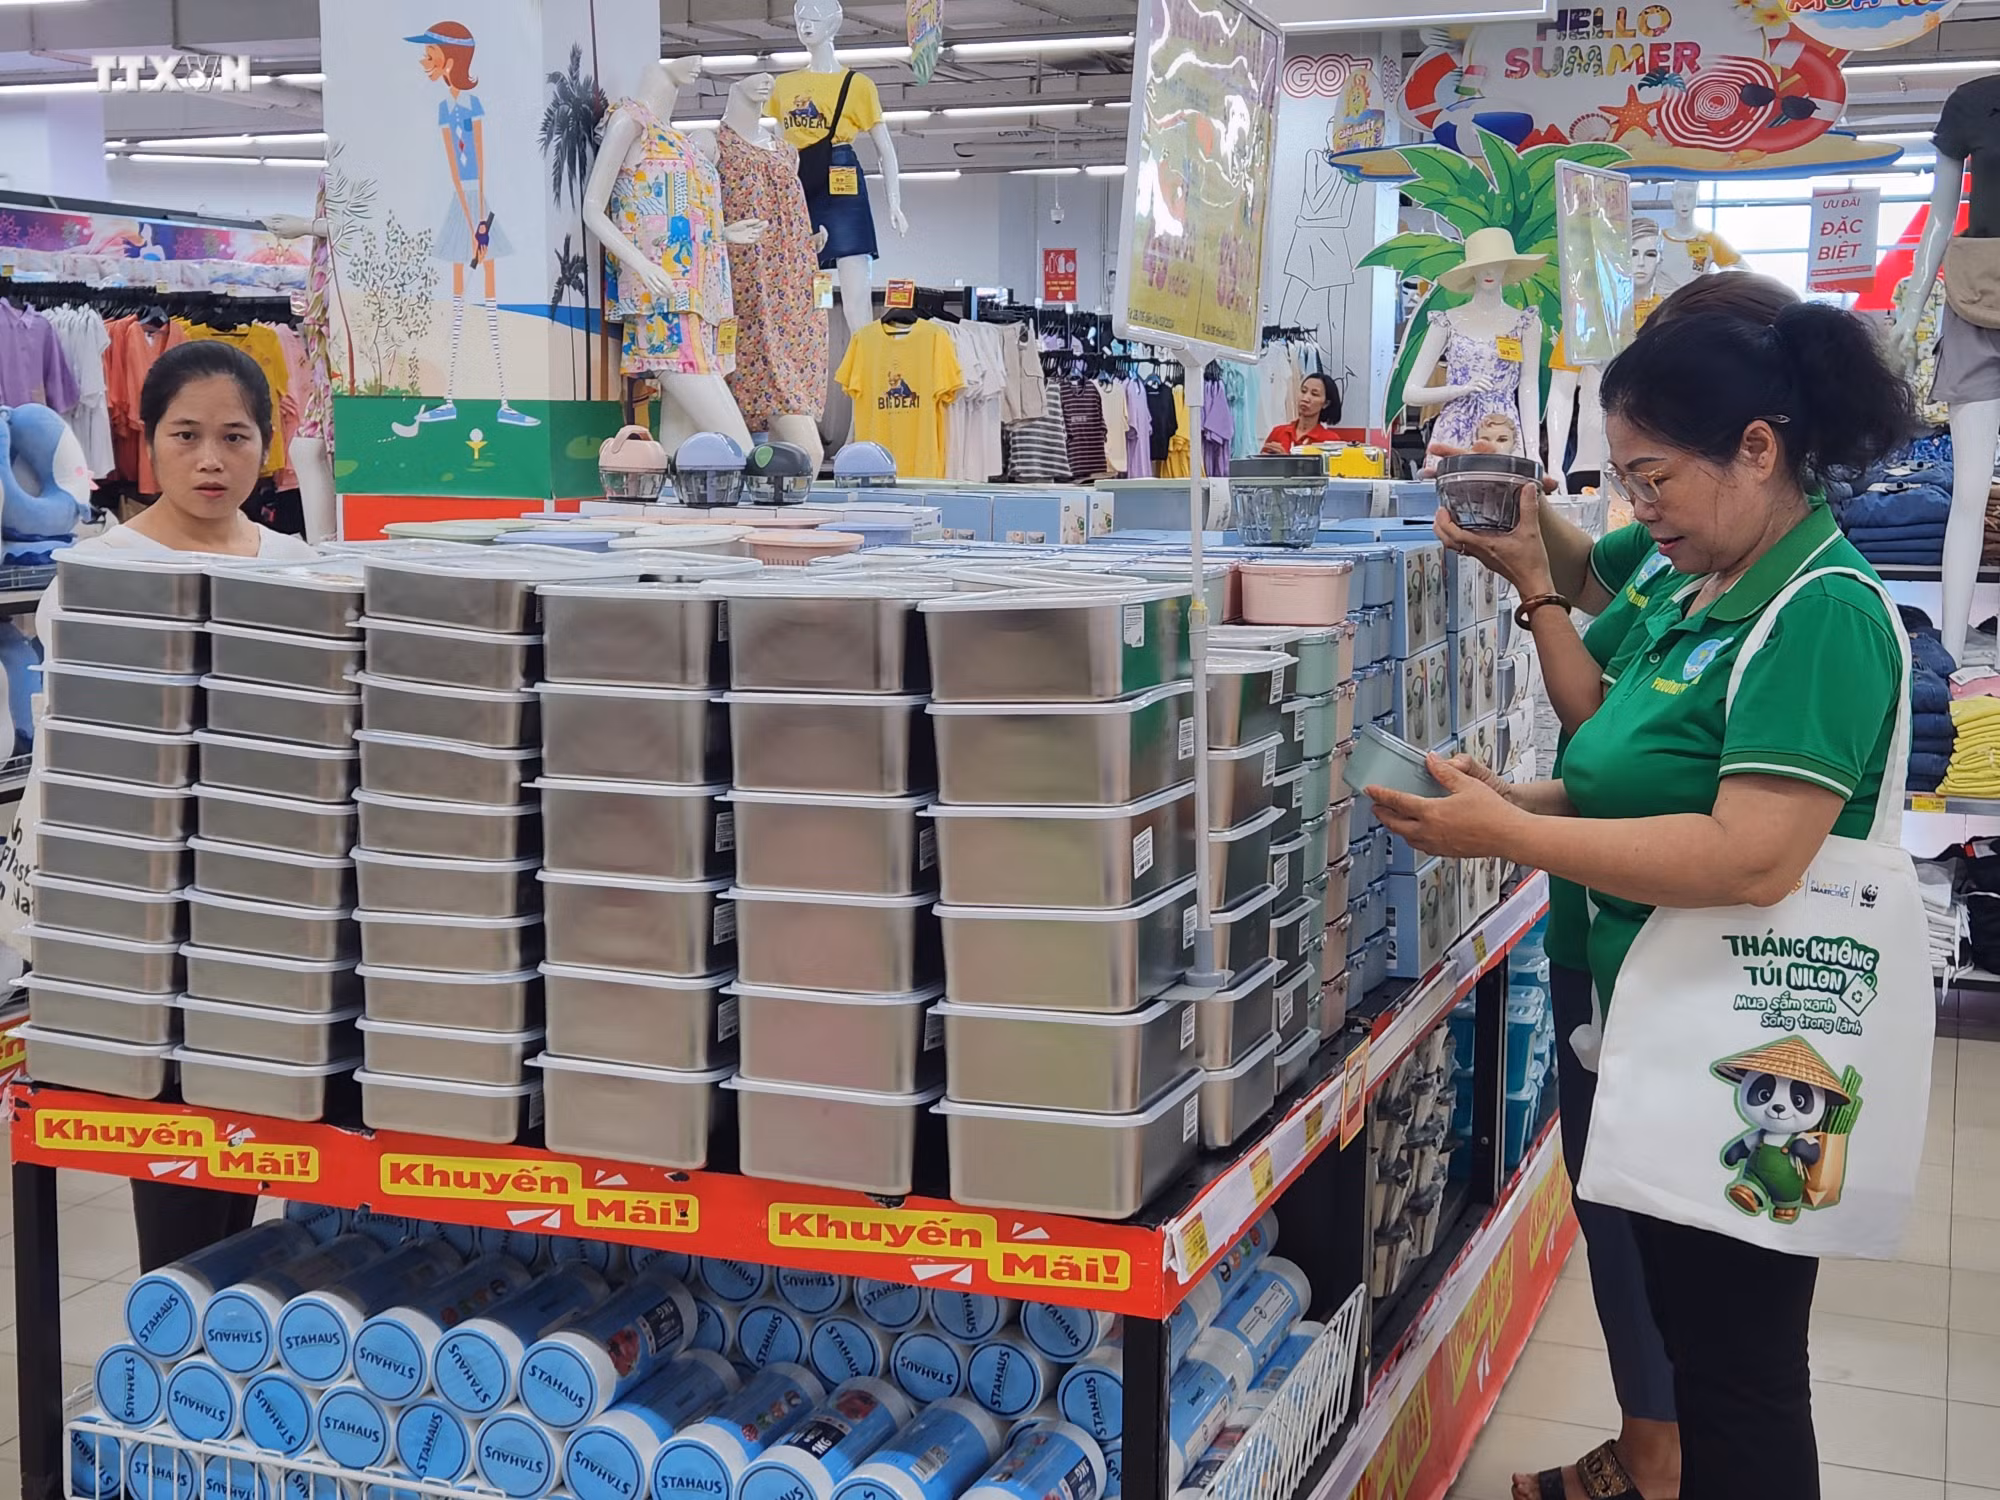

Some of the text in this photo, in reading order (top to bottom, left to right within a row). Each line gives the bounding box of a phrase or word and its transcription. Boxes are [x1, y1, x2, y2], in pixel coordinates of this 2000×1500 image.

[1536, 5, 1672, 41] HELLO
[1505, 41, 1701, 79] SUMMER
[1823, 196, 1860, 209] ƯU ĐÃI
[1820, 215, 1863, 239] ĐẶC
[1818, 240, 1862, 262] BIỆT
[1722, 928, 1876, 972] THÁNG KHÔNG
[1743, 960, 1843, 992] TÚI NILON
[1734, 990, 1836, 1013] Mua sắm xanh
[1761, 1010, 1862, 1036] Sống trong lành
[43, 1118, 203, 1147] Khuyến
[219, 1151, 310, 1176] Mãi!
[390, 1162, 568, 1195] Khuyến
[587, 1198, 689, 1227] Mãi!
[779, 1212, 982, 1248] Khuyến
[1002, 1252, 1120, 1284] Mãi!
[139, 1293, 179, 1343] STAHAUS
[208, 1328, 262, 1343] STAHAUS
[285, 1332, 340, 1349] STAHAUS
[756, 1313, 783, 1367] STAHAUS
[360, 1347, 416, 1380] STAHAUS
[448, 1343, 491, 1404] STAHAUS
[900, 1355, 954, 1386] STAHAUS
[990, 1350, 1010, 1408] STAHAUS
[125, 1356, 135, 1418] STAHAUS
[528, 1365, 585, 1409] STAHAUS
[173, 1390, 226, 1422] STAHAUS
[254, 1388, 297, 1445] STAHAUS
[1084, 1377, 1107, 1436] STAHAUS
[323, 1416, 379, 1443] STAHAUS
[416, 1411, 443, 1474] STAHAUS
[484, 1445, 544, 1474] STAHAUS
[811, 1437, 833, 1455] 1KG
[573, 1450, 631, 1495] STAHAUS
[661, 1475, 722, 1495] STAHAUS
